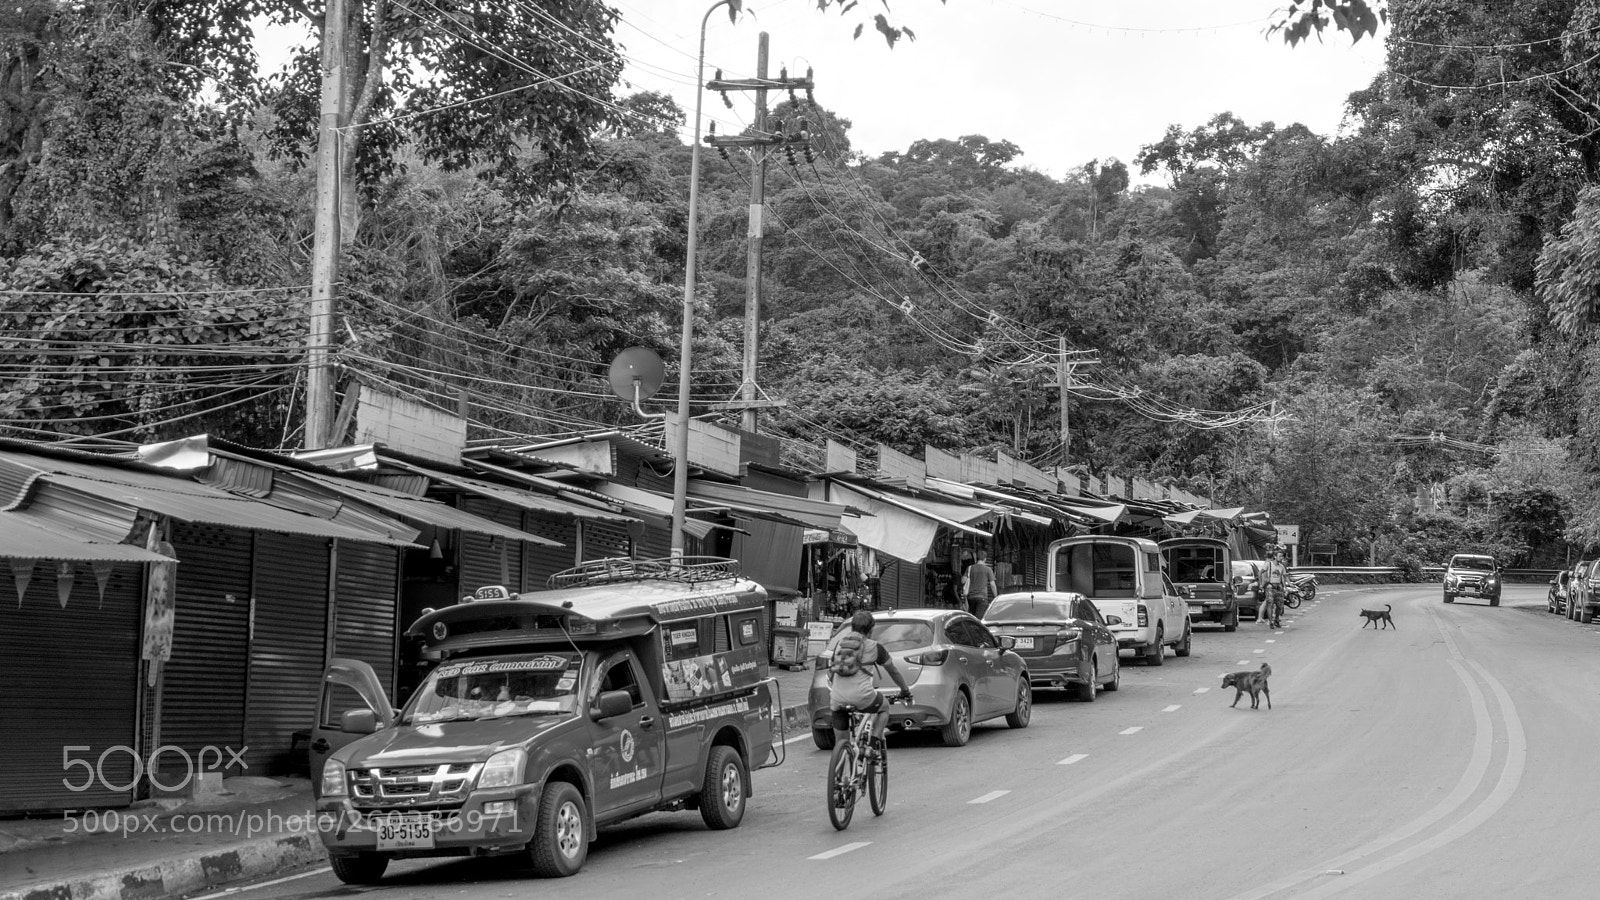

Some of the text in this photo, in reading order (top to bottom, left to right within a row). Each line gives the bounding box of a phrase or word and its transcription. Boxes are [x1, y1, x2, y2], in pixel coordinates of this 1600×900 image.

[437, 667, 461, 679] RED
[462, 664, 487, 675] CAR
[488, 660, 558, 672] CHIANGMAI
[380, 824, 430, 840] 30-5155
